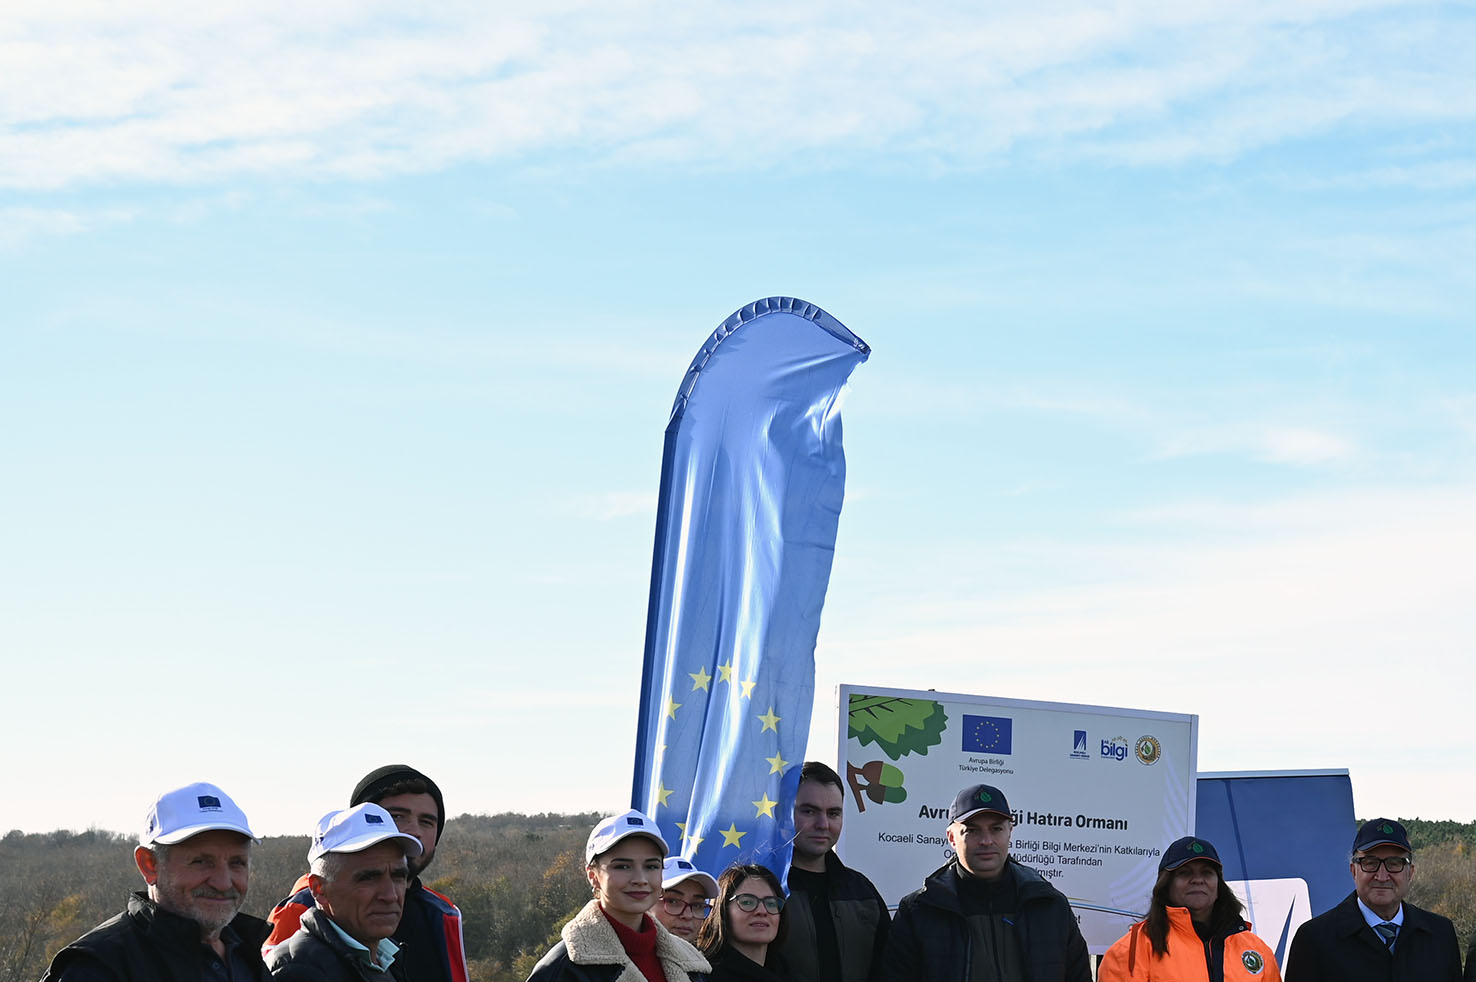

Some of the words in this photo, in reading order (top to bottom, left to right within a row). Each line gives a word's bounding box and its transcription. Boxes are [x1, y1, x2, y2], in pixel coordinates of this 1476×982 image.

[968, 756, 988, 765] Avrupa
[1101, 739, 1128, 762] bilgi
[918, 804, 949, 820] Avr
[1027, 811, 1073, 827] Hatıra
[1075, 814, 1128, 831] Ormanı
[878, 832, 914, 844] Kocaeli
[1015, 839, 1040, 852] Birliği
[1042, 841, 1062, 853] Bilgi
[1063, 842, 1112, 854] Merkezi'nin
[1114, 845, 1161, 858] Katkılarıyla
[1057, 855, 1103, 867] Tarafından
